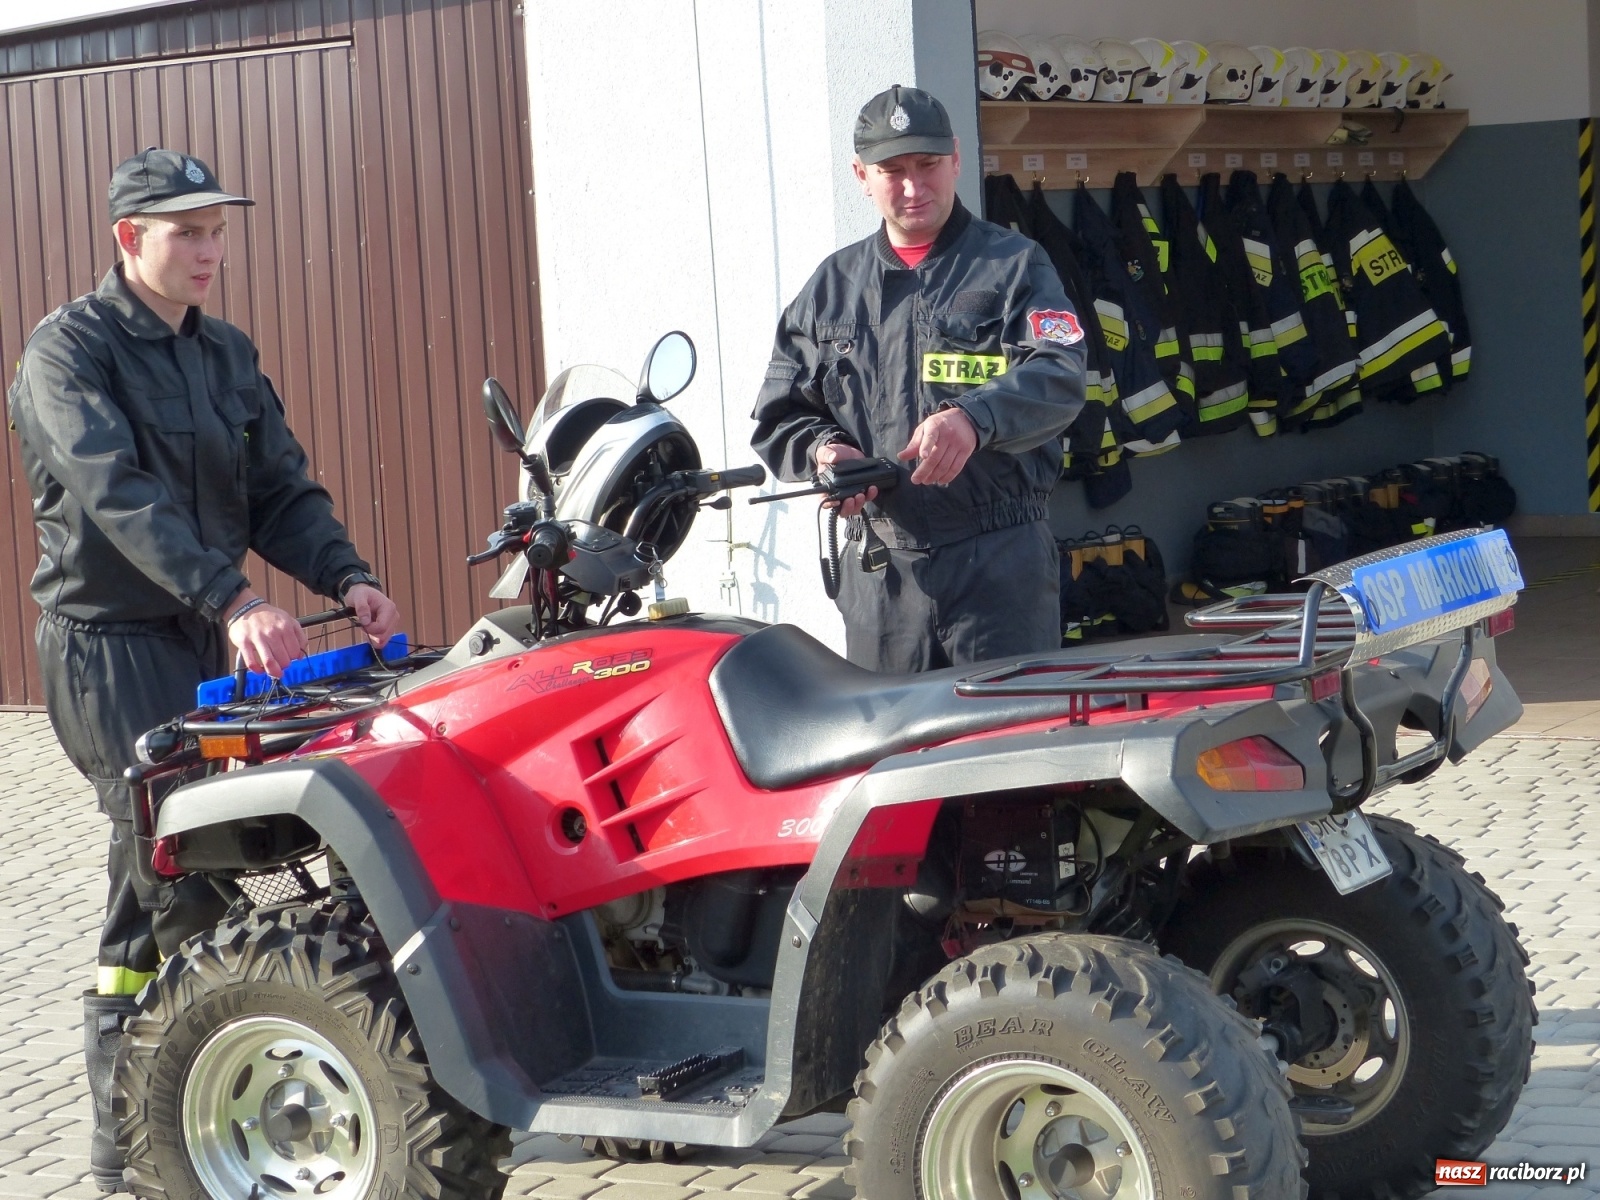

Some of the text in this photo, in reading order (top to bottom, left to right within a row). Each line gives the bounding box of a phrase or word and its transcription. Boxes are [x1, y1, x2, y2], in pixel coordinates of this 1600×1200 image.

[1362, 568, 1408, 626] OSP
[593, 659, 652, 680] 300
[777, 816, 827, 838] 300
[150, 988, 247, 1149] POWER GRIP
[953, 1015, 1053, 1048] BEAR
[1081, 1037, 1177, 1124] CLAW
